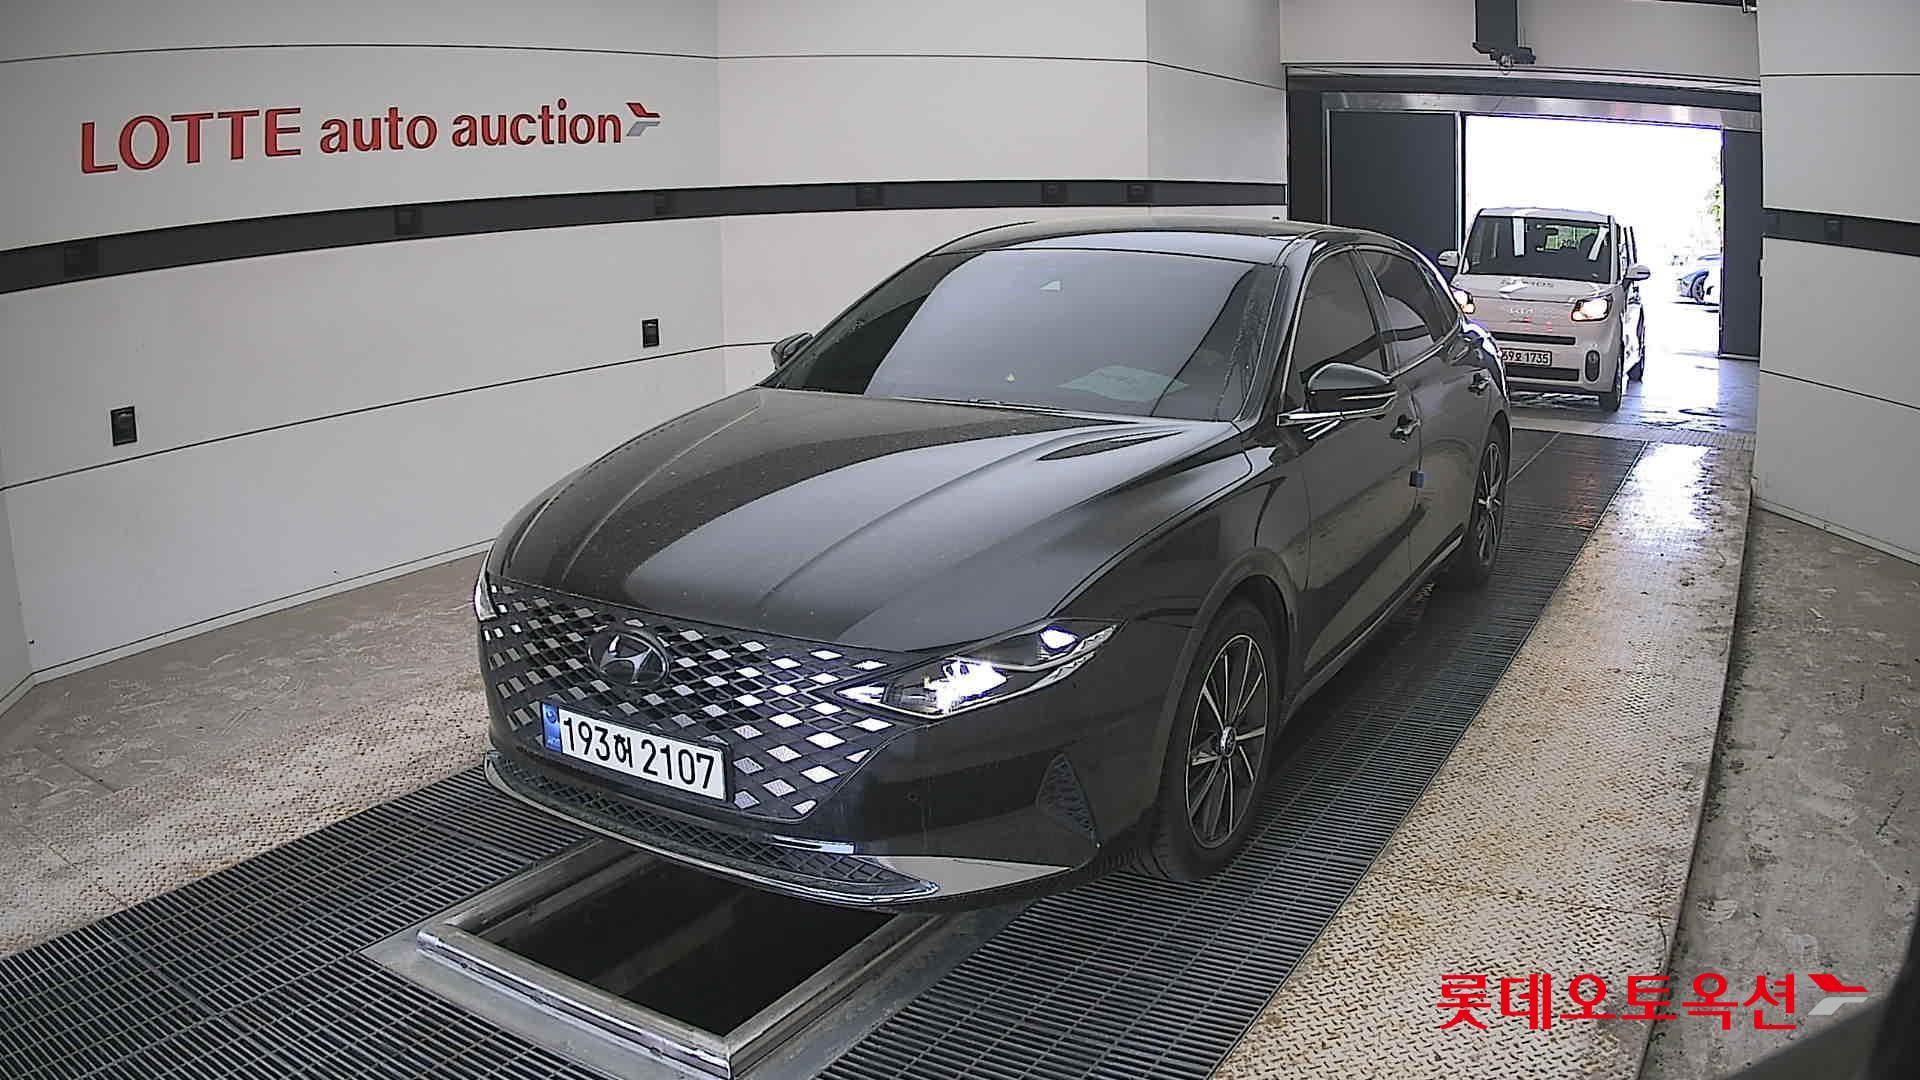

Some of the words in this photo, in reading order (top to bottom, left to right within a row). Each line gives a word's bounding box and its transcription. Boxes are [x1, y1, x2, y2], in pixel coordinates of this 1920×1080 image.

[81, 108, 301, 174] LOTTE
[320, 106, 436, 154] auto
[452, 99, 622, 147] auction
[1525, 351, 1549, 364] 1735
[564, 717, 634, 769] 193허
[640, 739, 715, 790] 2107
